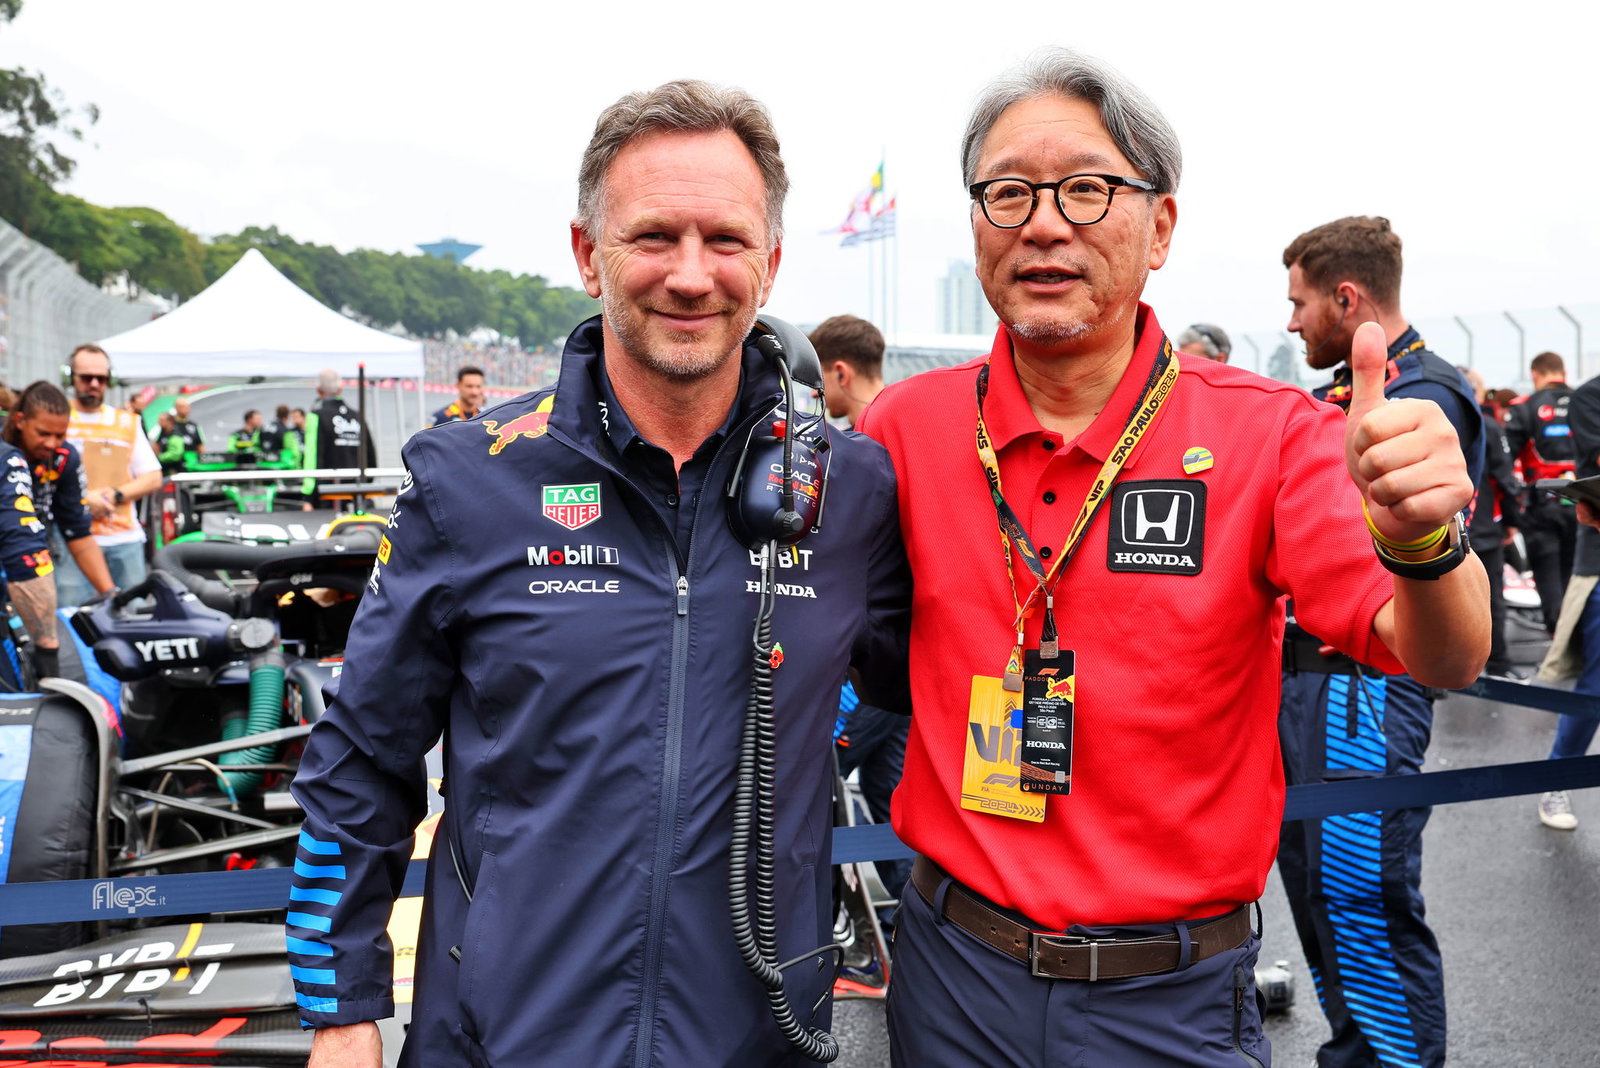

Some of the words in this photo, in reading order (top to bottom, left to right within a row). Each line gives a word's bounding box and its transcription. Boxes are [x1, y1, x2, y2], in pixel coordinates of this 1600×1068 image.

[1111, 436, 1135, 465] SAO
[1130, 399, 1160, 438] PAULO
[770, 463, 820, 489] OACLE
[548, 487, 595, 503] TAG
[1087, 479, 1105, 502] VIP
[546, 506, 598, 527] HEUER
[527, 545, 593, 566] Mobil
[748, 545, 813, 571] BBIT
[1114, 552, 1196, 568] HONDA
[528, 580, 620, 594] ORACLE
[135, 637, 199, 662] YETI
[1026, 740, 1066, 749] HONDA
